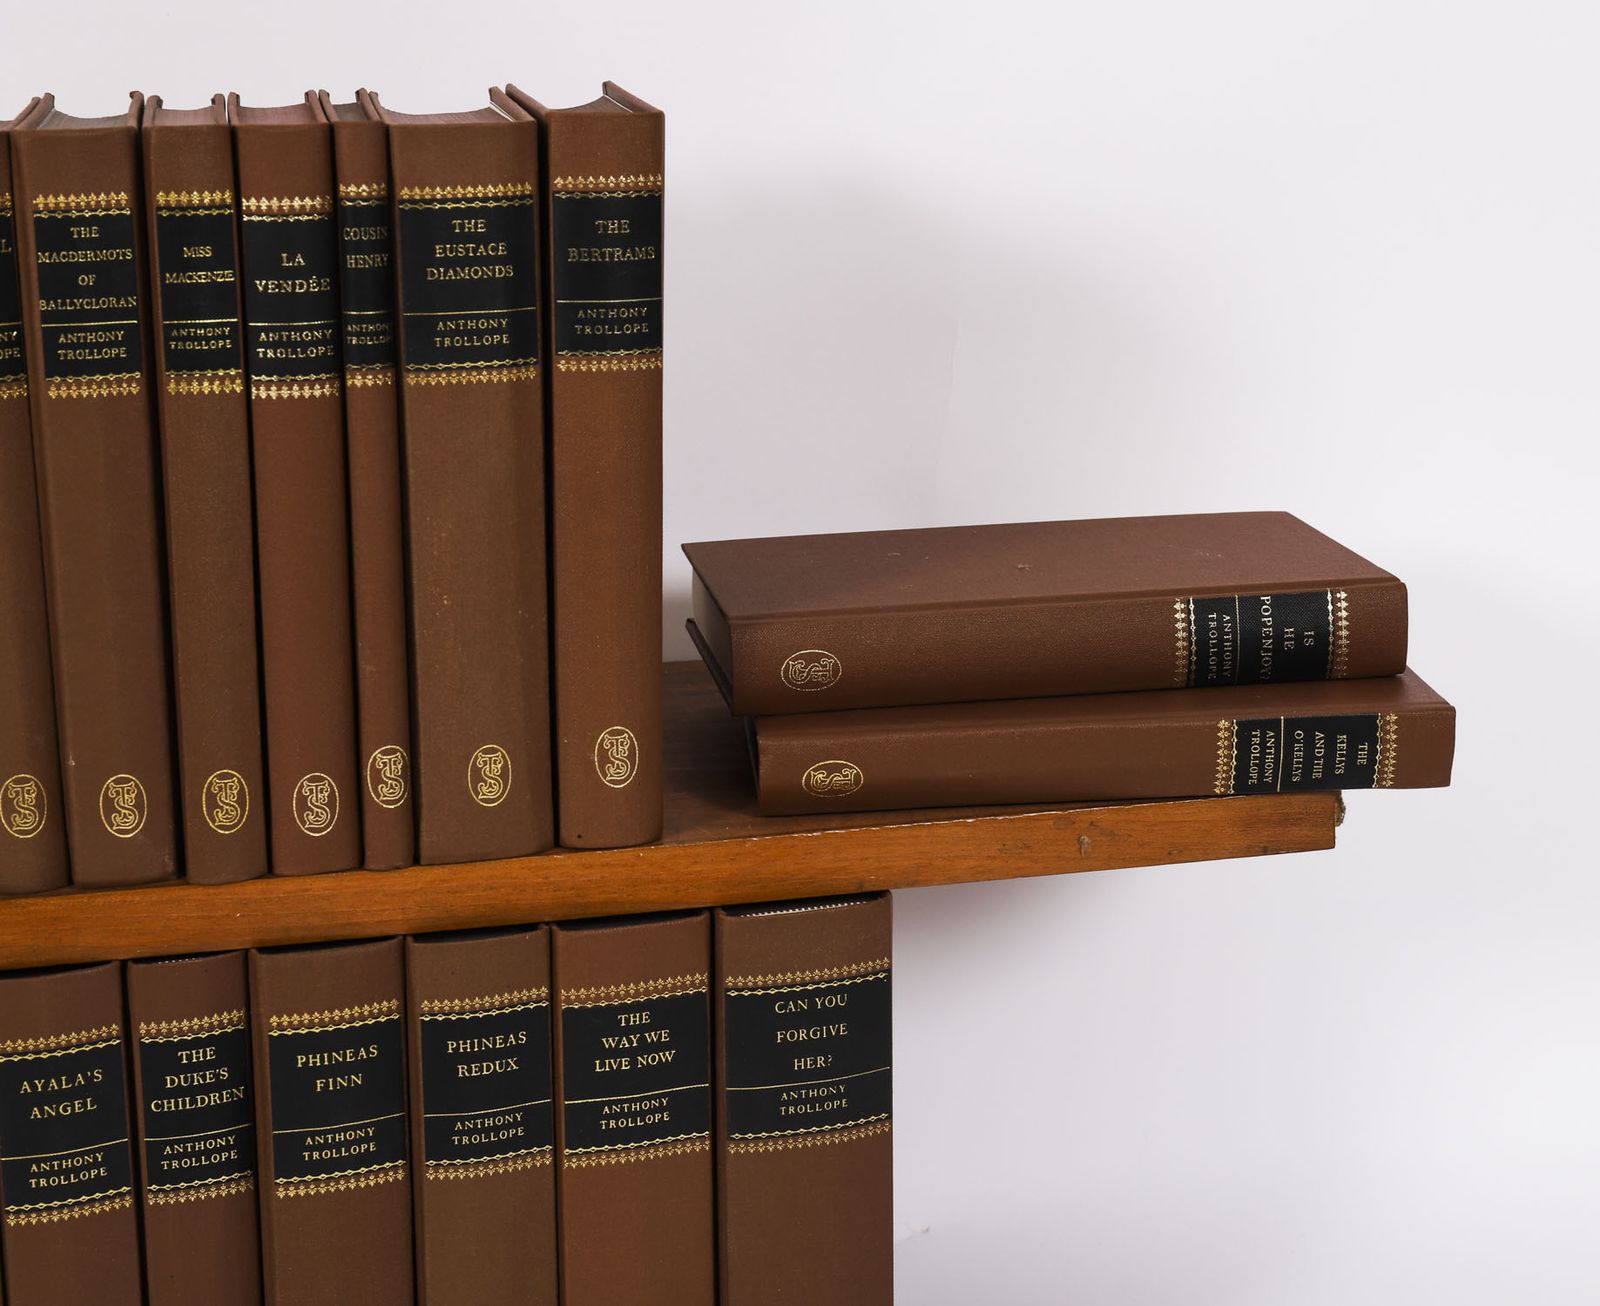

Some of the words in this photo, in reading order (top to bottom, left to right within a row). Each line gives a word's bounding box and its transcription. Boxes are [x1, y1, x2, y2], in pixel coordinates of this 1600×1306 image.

[69, 225, 100, 239] THE
[451, 218, 487, 233] THE
[594, 219, 631, 234] THE
[36, 248, 133, 266] MACDERMOTS
[182, 245, 213, 258] MISS
[434, 241, 508, 258] EUSTACE
[567, 246, 655, 262] BERTRAMS
[280, 252, 306, 267] LA
[345, 253, 391, 270] HENRY
[77, 274, 97, 286] OF
[165, 269, 237, 284] MACKENZIE
[426, 264, 514, 281] DIAMONDS
[253, 275, 331, 294] VENDÉE
[38, 294, 137, 313] BALLYCLORAN
[577, 307, 648, 319] ANTHONY
[171, 326, 231, 337] ANTHONY
[436, 317, 509, 331] ANTHONY
[574, 322, 649, 335] TROLLOPE
[58, 330, 125, 344] ANTHONY
[168, 339, 233, 350] TROLLOPE
[258, 328, 333, 343] ANTHONY
[433, 333, 510, 348] TROLLOPE
[57, 346, 128, 361] TROLLOPE
[255, 345, 334, 359] TROLLOPE
[1222, 614, 1233, 677] ANTHONY
[1283, 627, 1295, 651] HE
[1303, 630, 1315, 646] IS
[1247, 728, 1261, 785] TROLLOPE
[1263, 730, 1276, 784] ANTHONY
[1334, 734, 1348, 775] KELLYS
[1356, 741, 1369, 766] THE
[775, 998, 807, 1014] CAN
[814, 994, 848, 1010] YOU
[617, 1011, 651, 1027] THE
[446, 1030, 527, 1054] PHINEAS
[601, 1035, 641, 1049] WAY
[645, 1029, 670, 1044] WE
[776, 1023, 849, 1043] FORGIVE
[177, 1046, 217, 1064] THE
[295, 1044, 378, 1068] PHINEAS
[594, 1057, 631, 1073] LIVE
[638, 1050, 677, 1067] NOW
[793, 1054, 833, 1071] HER?
[457, 1057, 520, 1078] REDUX
[19, 1068, 103, 1094] AYALA'S
[164, 1067, 229, 1089] DUKE'S
[315, 1074, 363, 1093] FINN
[150, 1086, 245, 1113] CHILDREN
[780, 1084, 847, 1102] ANTHONY
[29, 1097, 98, 1120] ANGEL
[602, 1096, 670, 1116] ANTHONY
[779, 1098, 849, 1116] TROLLOPE
[454, 1112, 525, 1132] ANTHONY
[599, 1112, 671, 1130] TROLLOPE
[162, 1134, 237, 1156] ANTHONY
[305, 1127, 376, 1147] ANTHONY
[451, 1127, 525, 1146] TROLLOPE
[160, 1149, 238, 1170] TROLLOPE
[302, 1141, 377, 1161] TROLLOPE
[29, 1152, 106, 1174] ANTHONY
[28, 1166, 108, 1189] TROLLOPE
